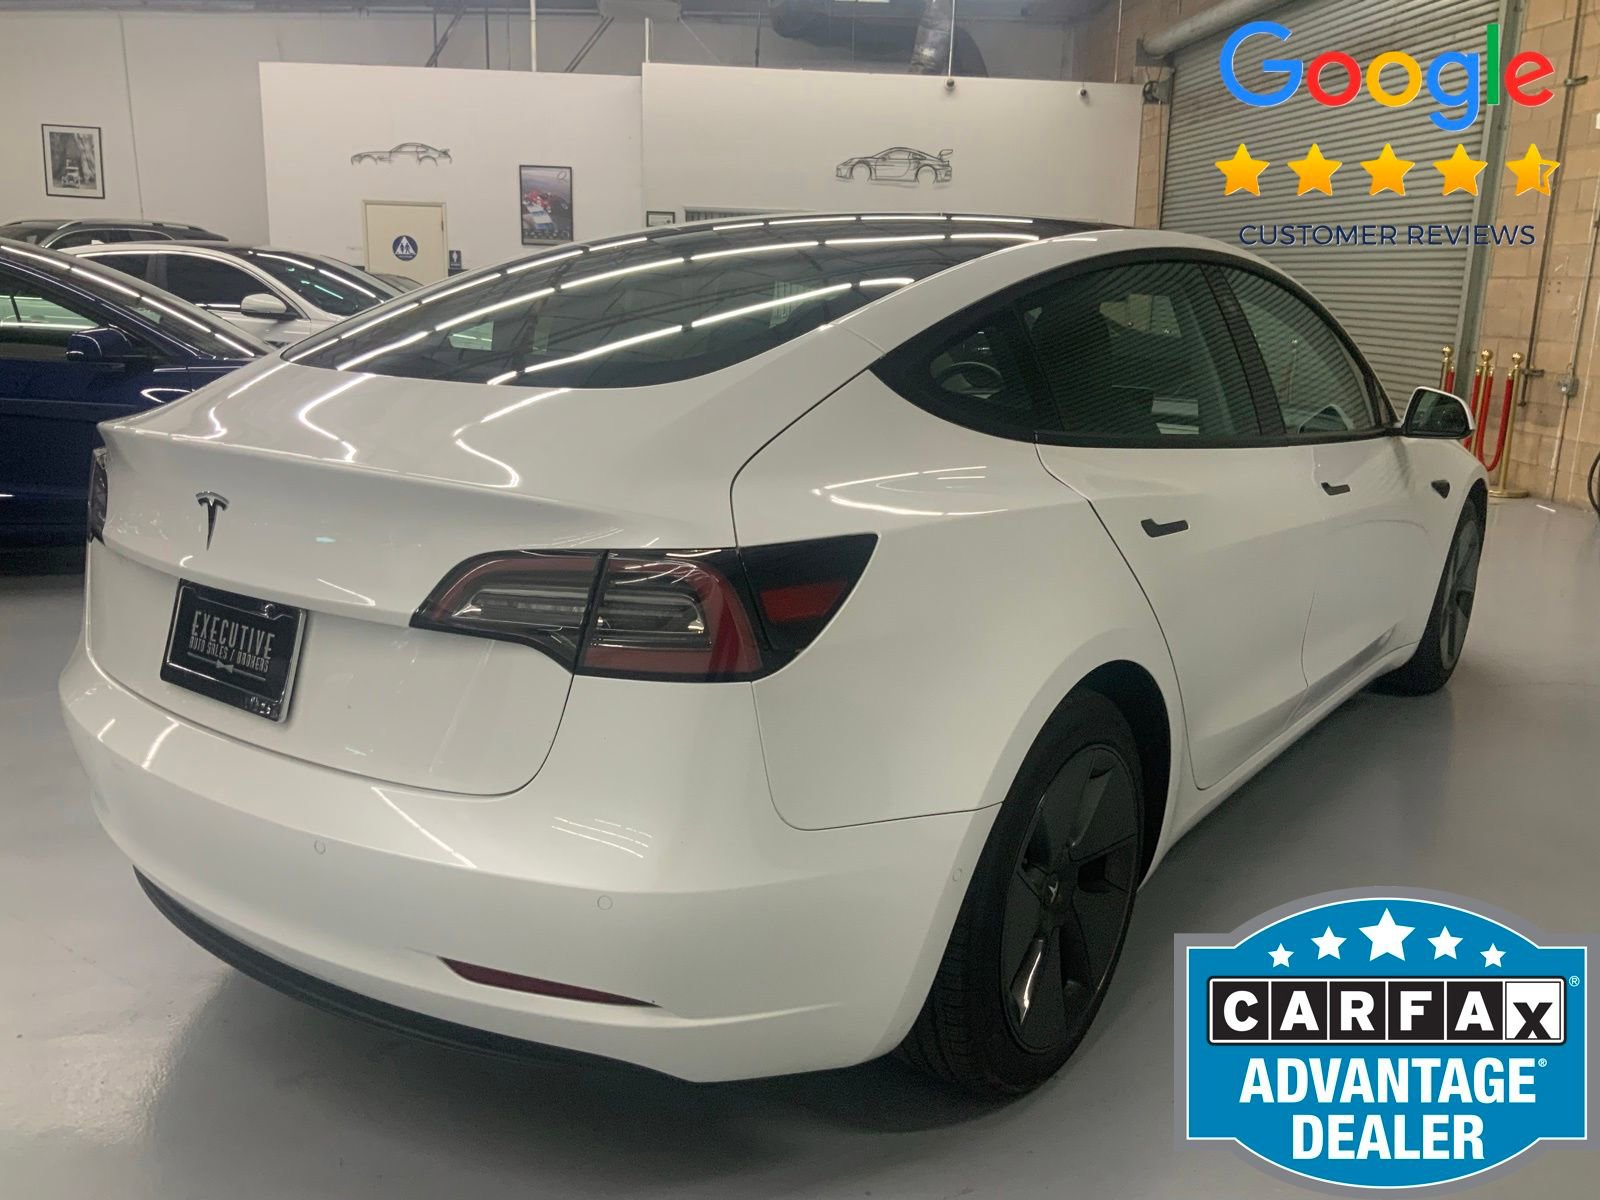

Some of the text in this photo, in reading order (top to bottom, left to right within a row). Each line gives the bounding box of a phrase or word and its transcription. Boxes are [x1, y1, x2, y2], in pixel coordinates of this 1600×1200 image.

[191, 610, 276, 660] EXECUTIVE
[206, 641, 229, 661] SALES
[236, 650, 271, 673] BROKERS
